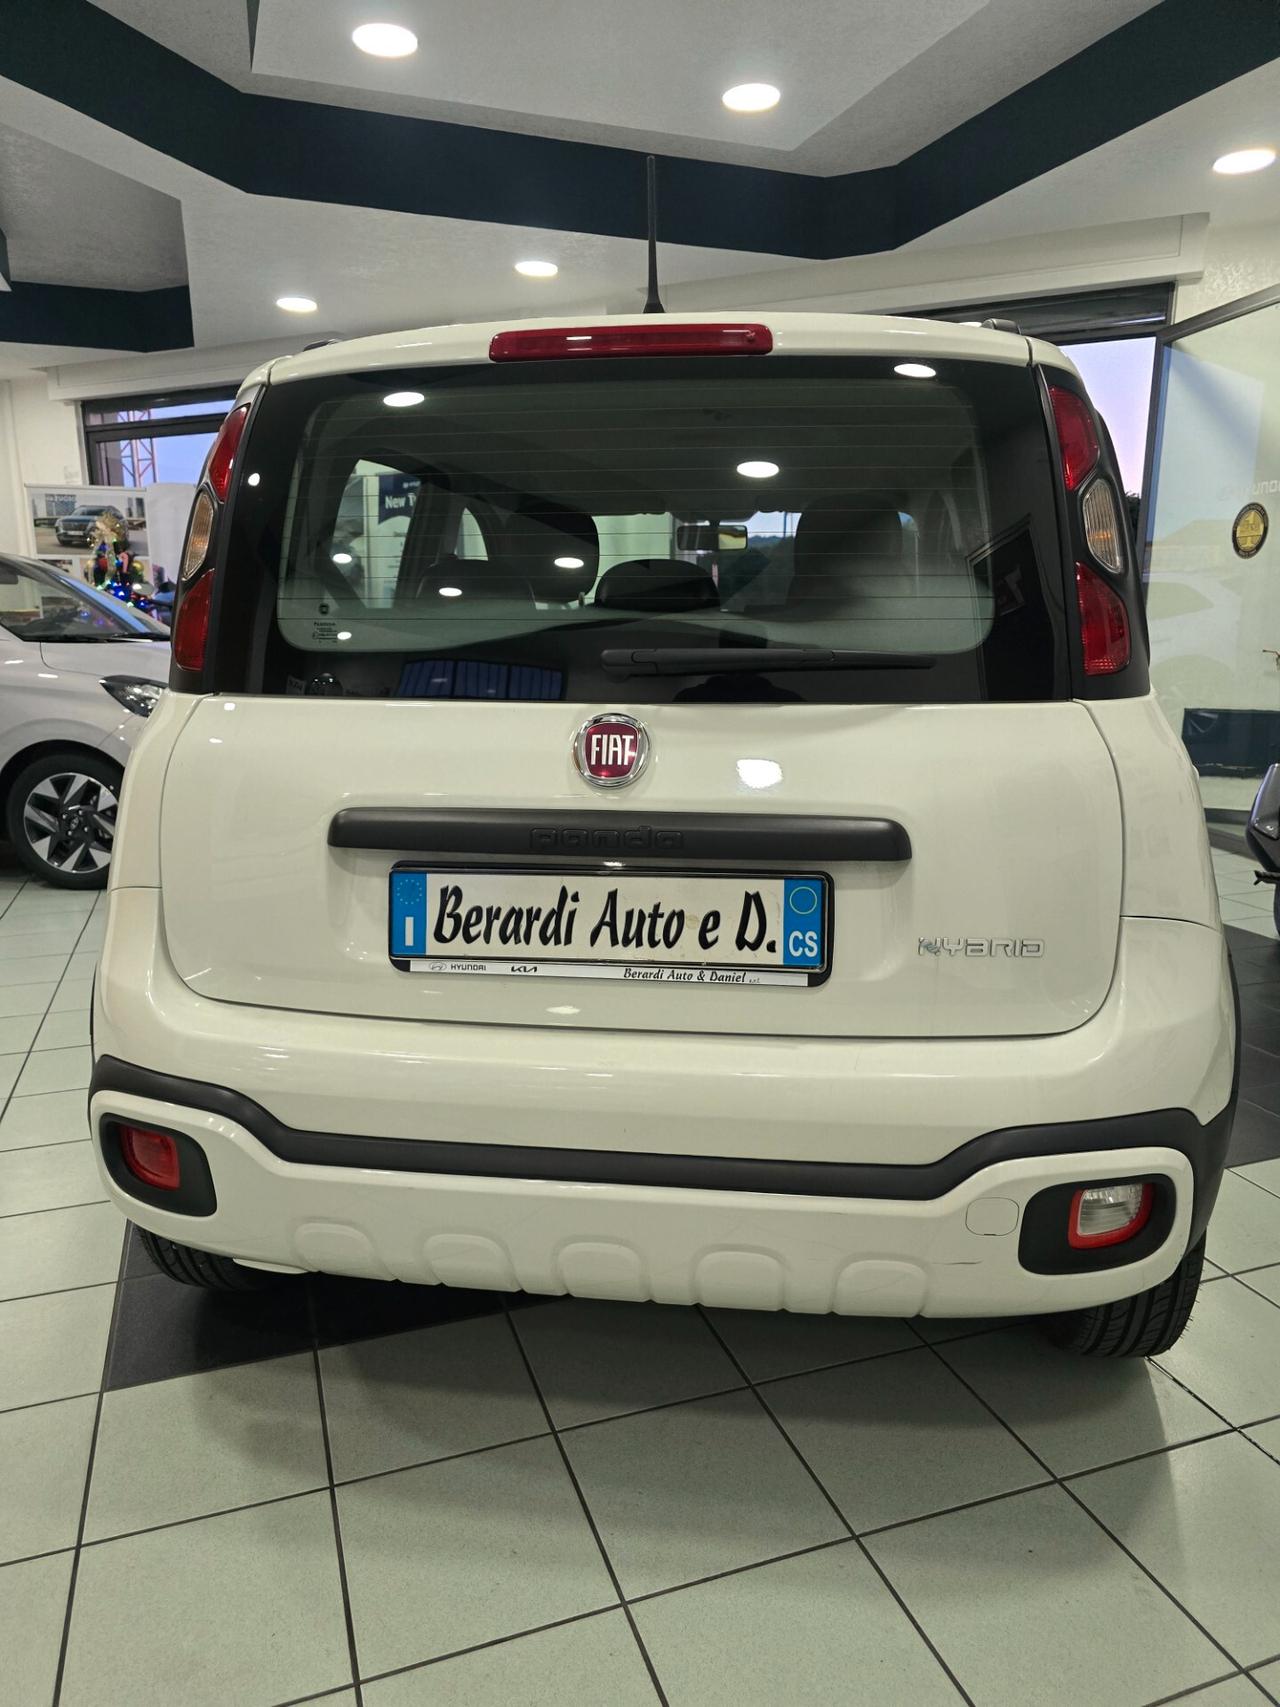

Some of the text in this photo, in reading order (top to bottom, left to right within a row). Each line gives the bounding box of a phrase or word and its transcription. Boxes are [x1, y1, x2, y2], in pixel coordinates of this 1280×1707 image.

[384, 495, 406, 509] New
[590, 734, 635, 766] FIAT
[530, 825, 683, 849] panda
[433, 884, 777, 953] Berardi Auto e D.
[788, 930, 818, 958] CS
[918, 937, 1045, 957] HYBRID
[450, 963, 538, 973] HYUNDAI KIA
[623, 967, 665, 979] Berardi
[667, 969, 693, 981] Auto
[696, 969, 706, 981] &
[709, 971, 747, 983] Daniel
